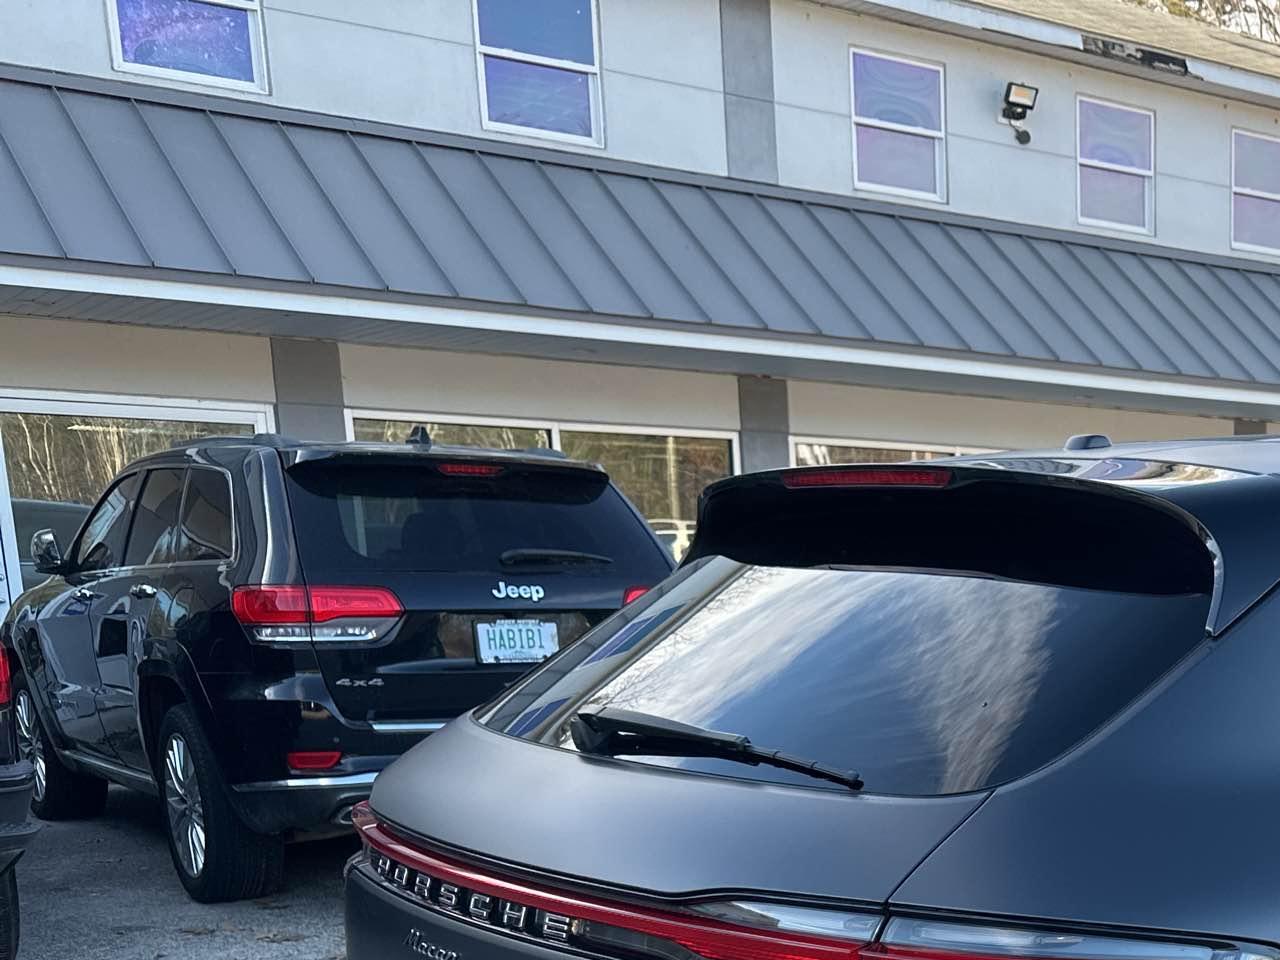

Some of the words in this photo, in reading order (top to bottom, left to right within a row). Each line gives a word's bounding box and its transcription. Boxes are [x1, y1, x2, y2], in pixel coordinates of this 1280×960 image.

[492, 580, 545, 602] Jeep
[487, 629, 545, 650] HABIBI
[335, 678, 385, 688] 4x4
[376, 855, 572, 944] PORSCHE
